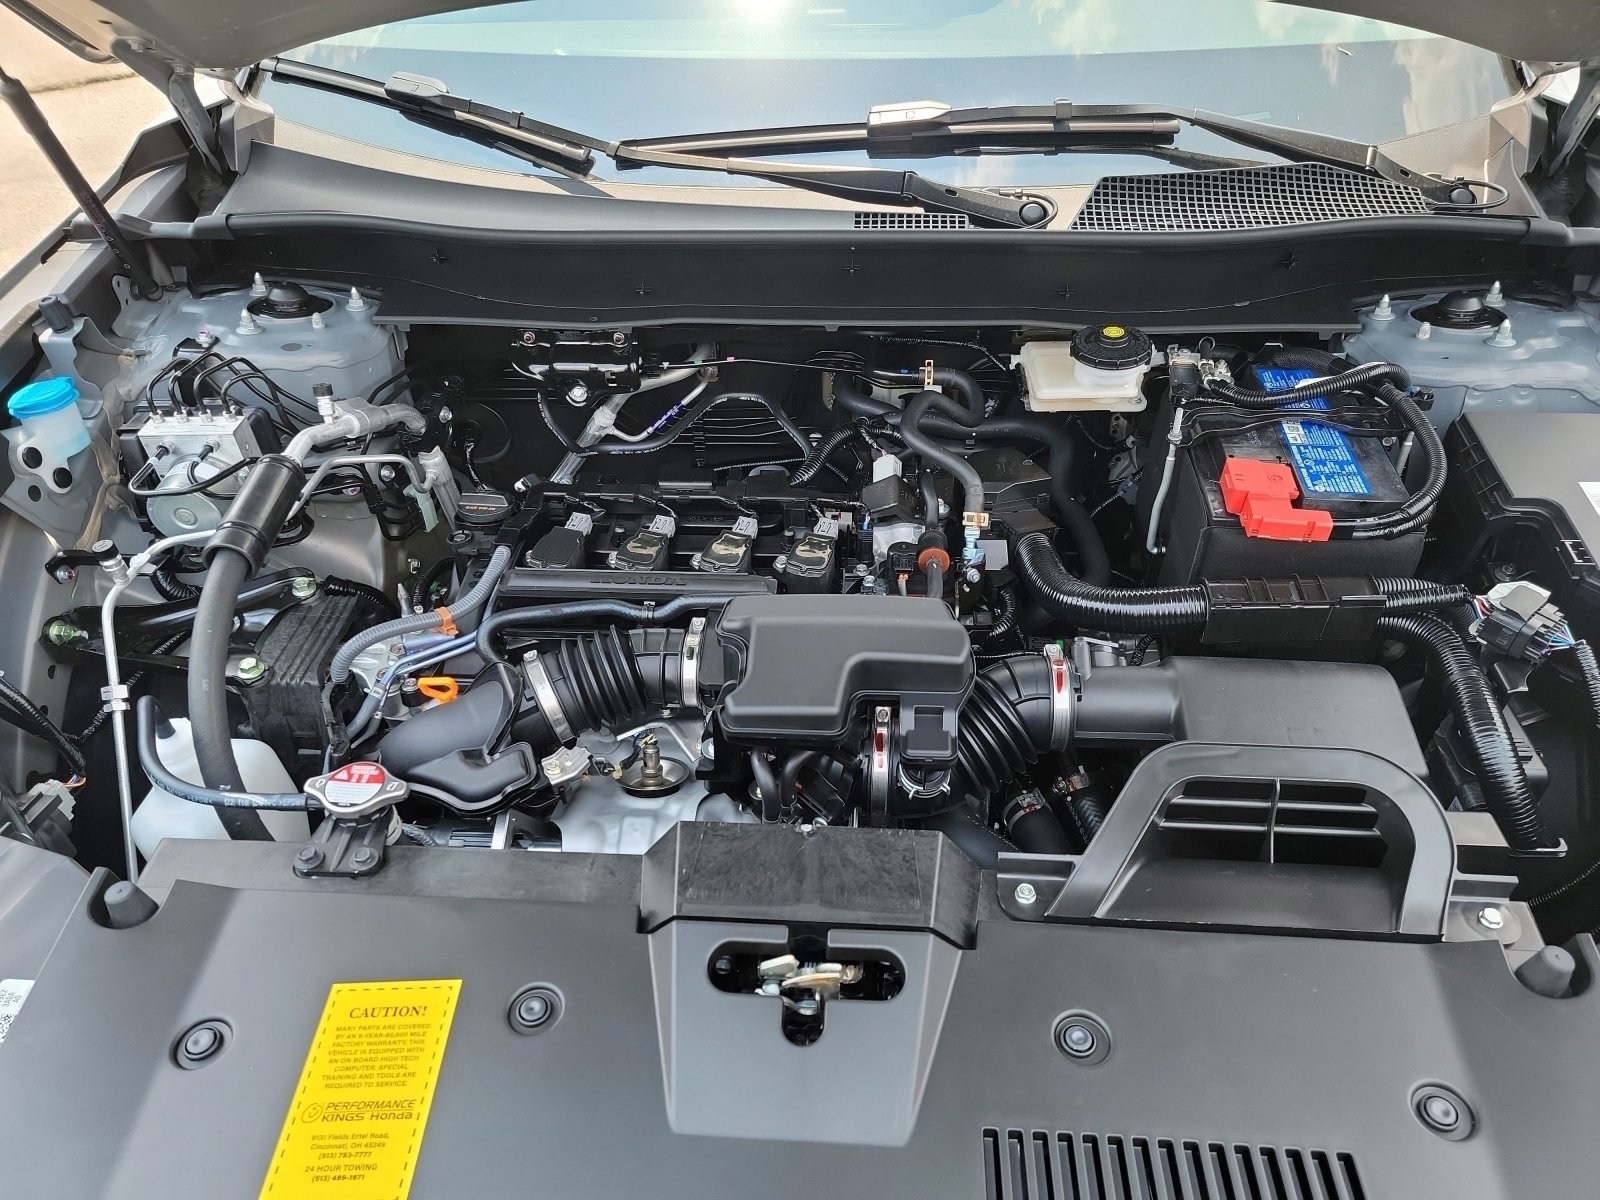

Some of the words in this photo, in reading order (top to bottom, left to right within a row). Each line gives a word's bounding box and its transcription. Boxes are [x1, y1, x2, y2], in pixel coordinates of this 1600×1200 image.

[590, 574, 686, 586] HONDA
[349, 1006, 428, 1019] CAUTION!
[326, 1099, 417, 1111] PERFORMANCE
[321, 1111, 366, 1123] KINGS
[370, 1111, 413, 1121] Honda
[318, 1152, 337, 1160] (513)
[343, 1163, 378, 1172] TOWING
[311, 1174, 331, 1183] (513)
